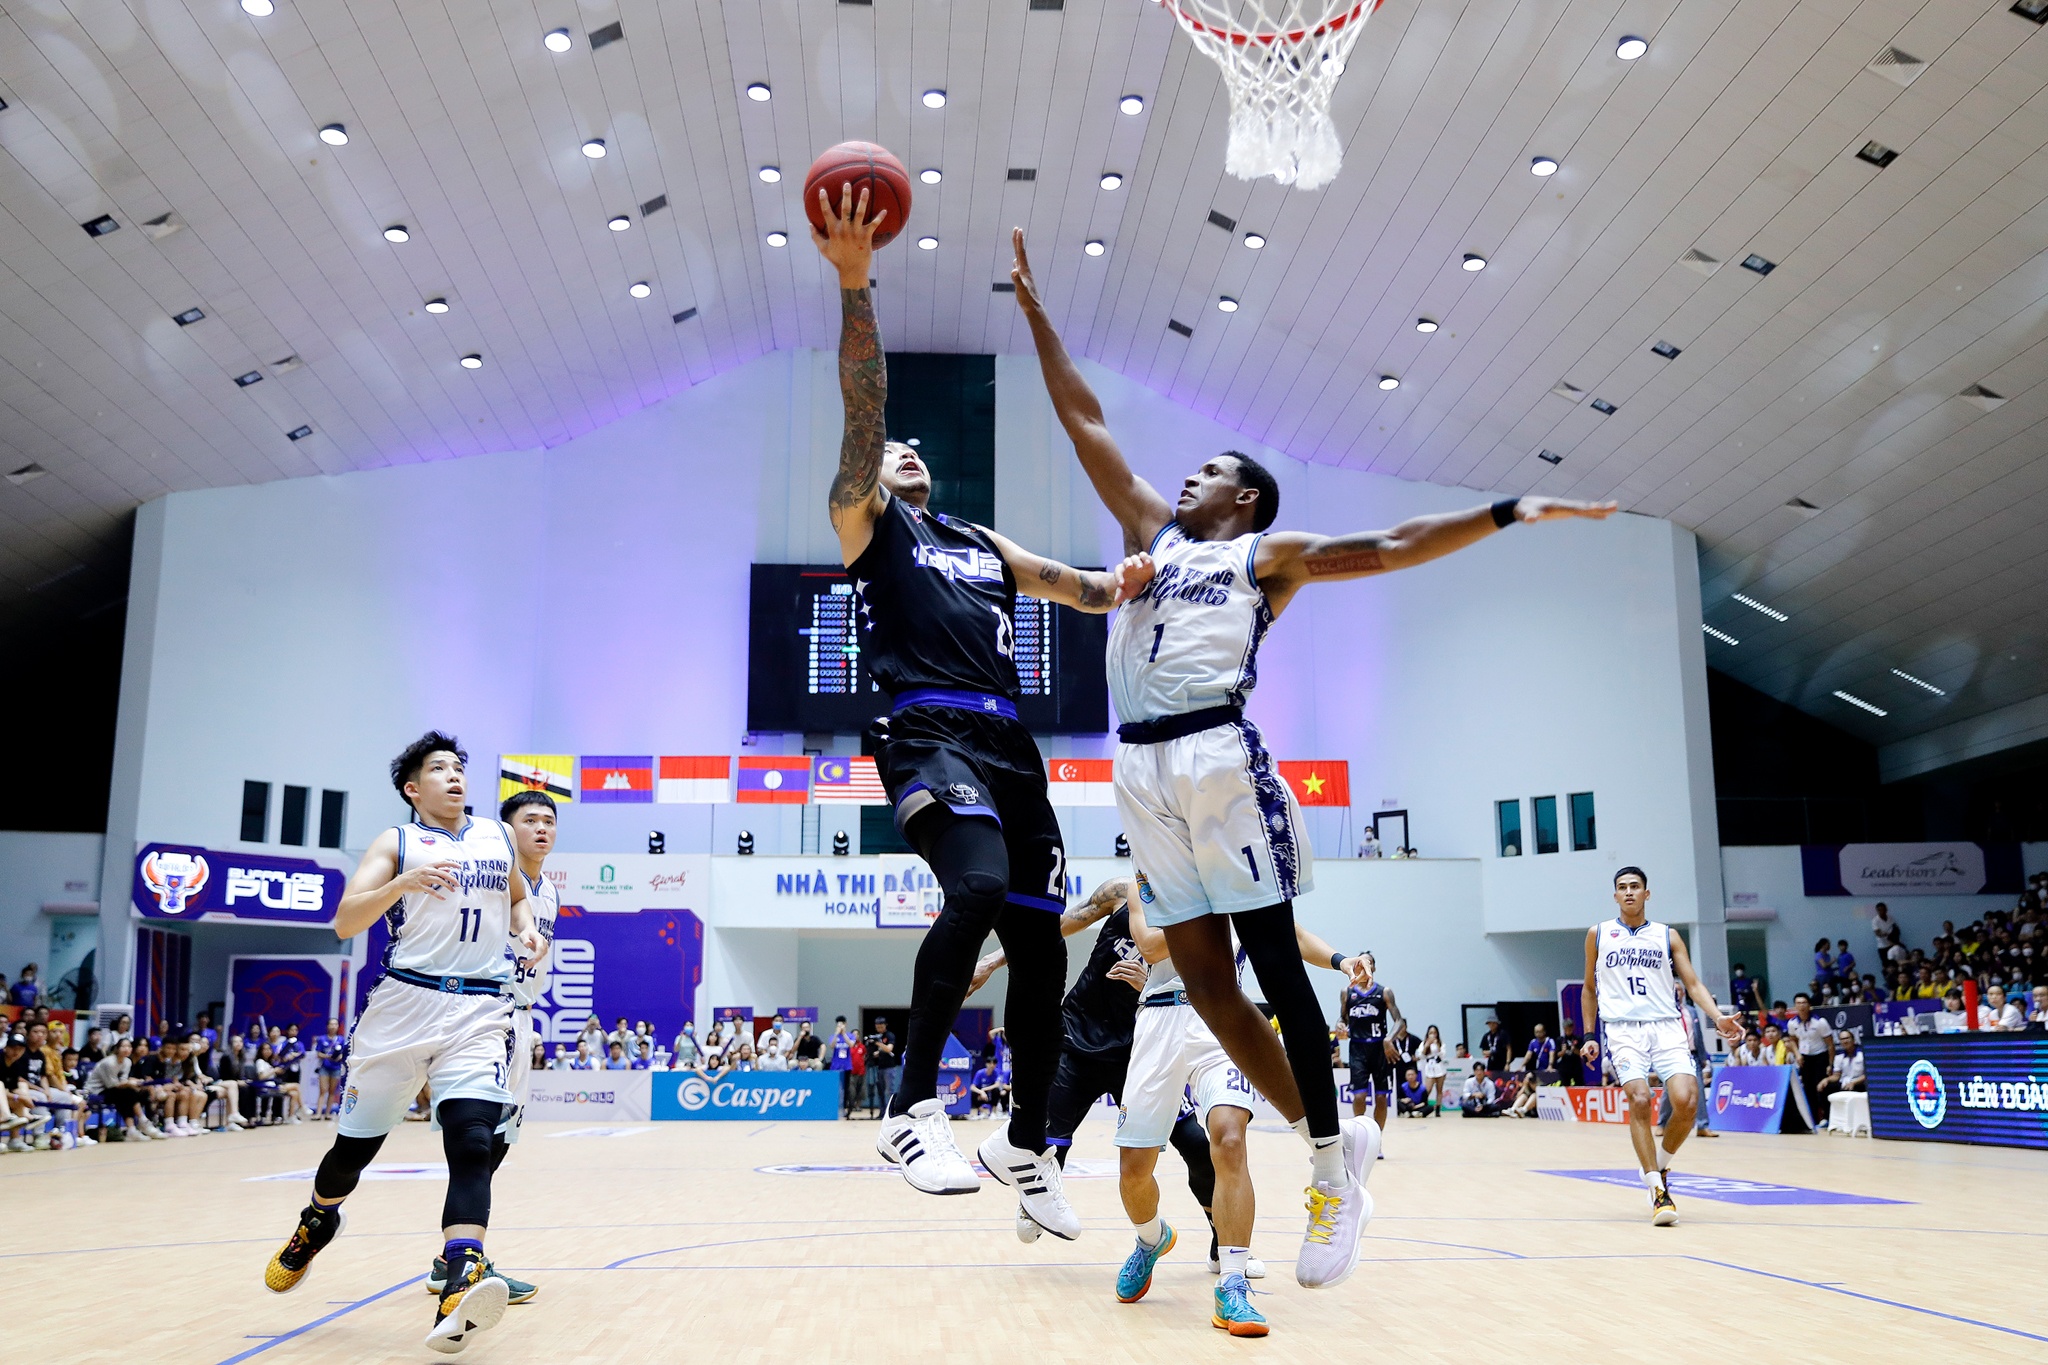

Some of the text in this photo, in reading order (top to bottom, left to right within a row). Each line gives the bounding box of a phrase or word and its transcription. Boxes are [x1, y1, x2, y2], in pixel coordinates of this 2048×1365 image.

[1310, 557, 1378, 574] SACRIFICE
[1149, 623, 1165, 664] 1
[229, 867, 325, 885] BUFFALOES
[475, 860, 508, 872] TRANG
[1241, 845, 1260, 882] 1
[1861, 866, 1937, 880] Leadvisors
[225, 879, 324, 911] PUB
[777, 869, 828, 895] NHÀ
[837, 874, 875, 895] THI
[459, 908, 482, 943] 11
[1606, 951, 1662, 970] Dolphins
[1620, 947, 1663, 959] NHA TRANG
[1627, 976, 1647, 996] 15
[1371, 1022, 1382, 1038] 15
[1226, 1067, 1250, 1095] 20
[1958, 1075, 2000, 1109] LIÊN
[711, 1081, 812, 1114] Casper
[1586, 1089, 1630, 1123] AWA
